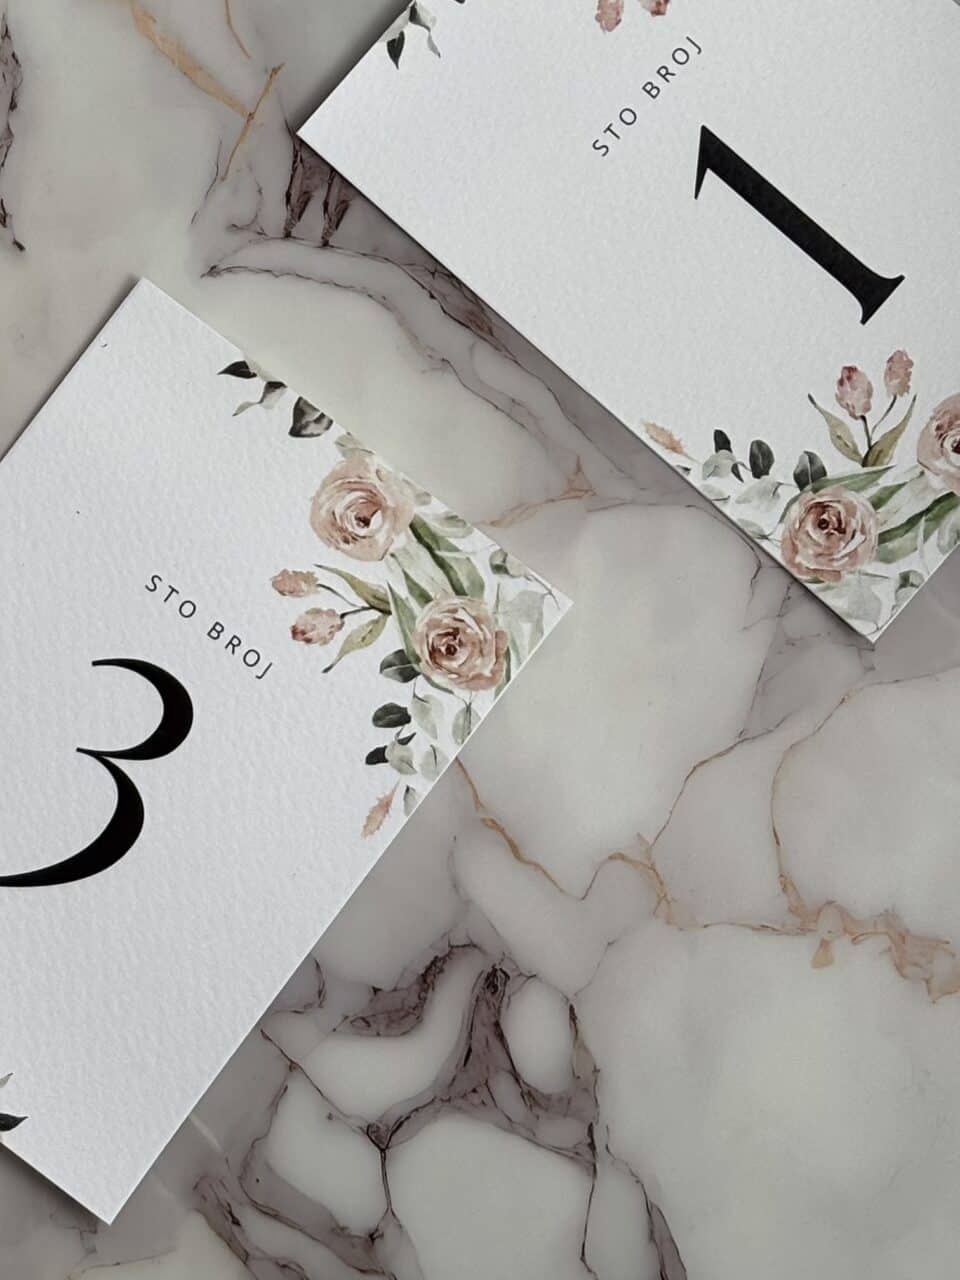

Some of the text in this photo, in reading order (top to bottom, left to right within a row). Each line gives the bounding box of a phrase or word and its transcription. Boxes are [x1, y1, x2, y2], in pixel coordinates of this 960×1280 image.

[592, 36, 703, 157] STO BROJ
[694, 125, 905, 326] 1
[144, 574, 274, 681] STO BROJ
